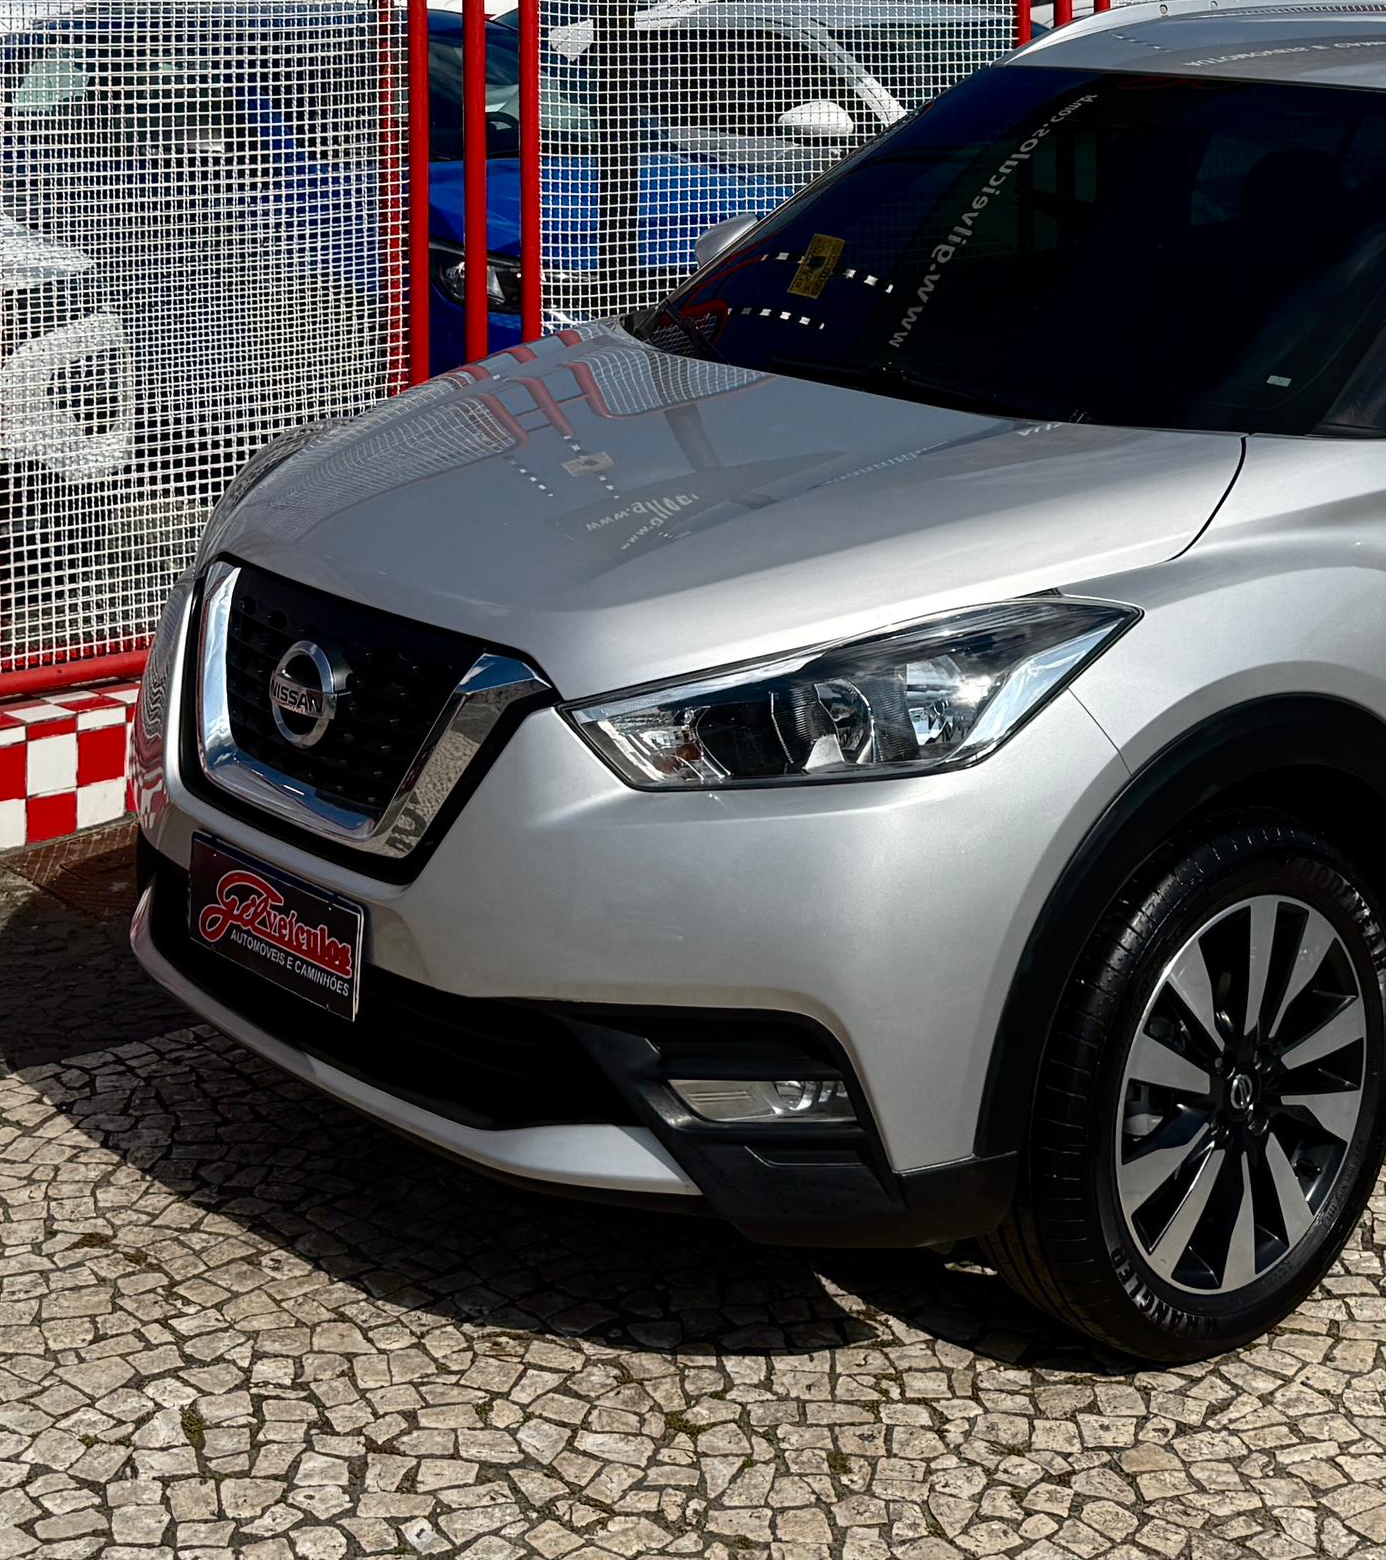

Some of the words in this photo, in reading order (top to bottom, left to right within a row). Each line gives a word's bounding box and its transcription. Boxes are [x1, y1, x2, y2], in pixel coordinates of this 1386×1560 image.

[270, 679, 324, 715] NISSAN
[230, 929, 286, 966] AUTOMÓVEIS
[286, 957, 294, 970] E
[294, 960, 350, 997] CAMINHÕES
